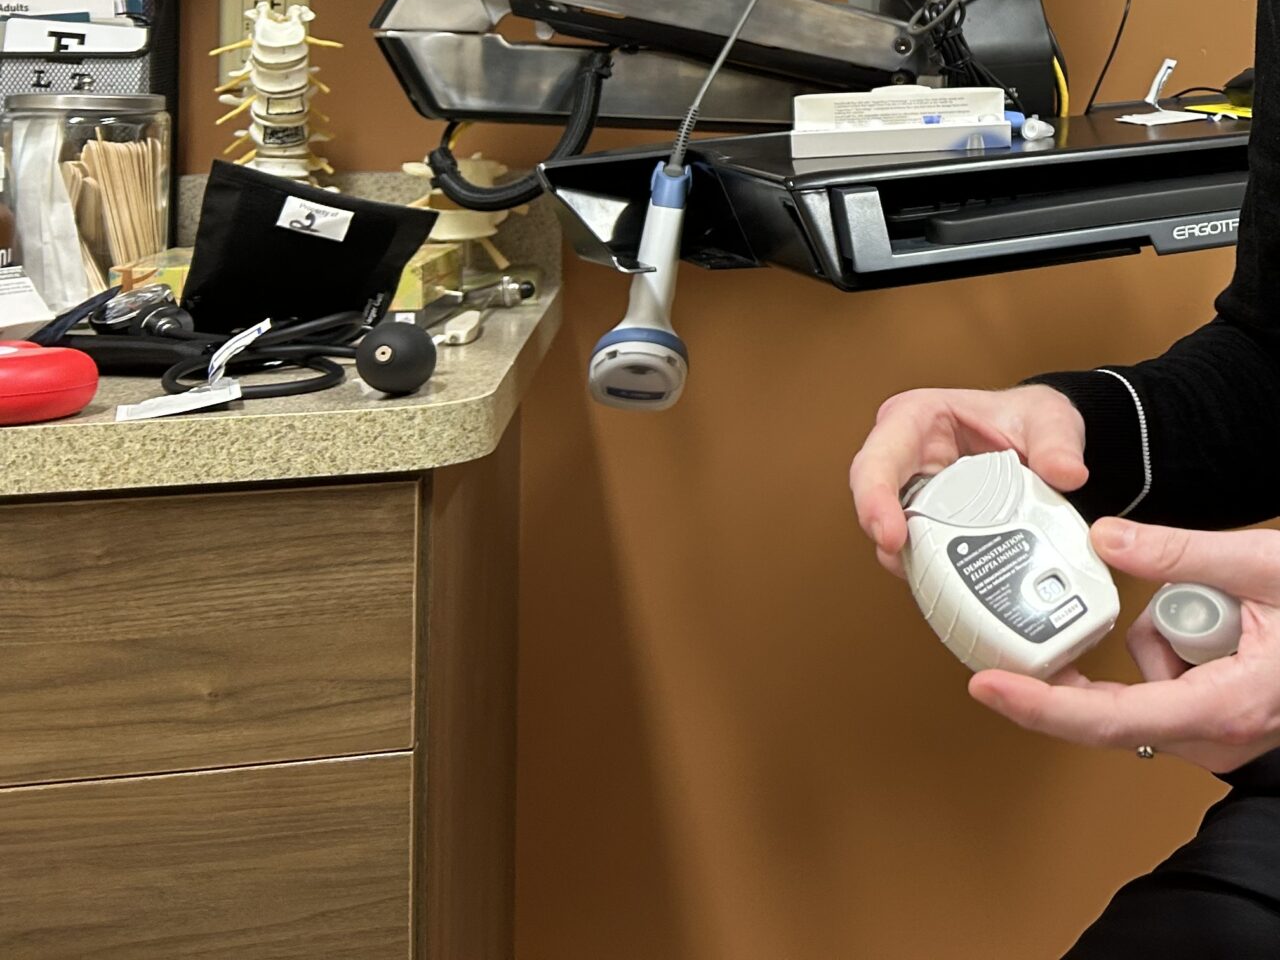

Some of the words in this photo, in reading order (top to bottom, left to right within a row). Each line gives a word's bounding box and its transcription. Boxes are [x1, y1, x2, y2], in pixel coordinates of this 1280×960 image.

[299, 203, 330, 217] Property
[289, 211, 320, 233] 2
[962, 532, 1025, 576] DEMONSTRATION
[970, 560, 999, 582] ELLIPTA
